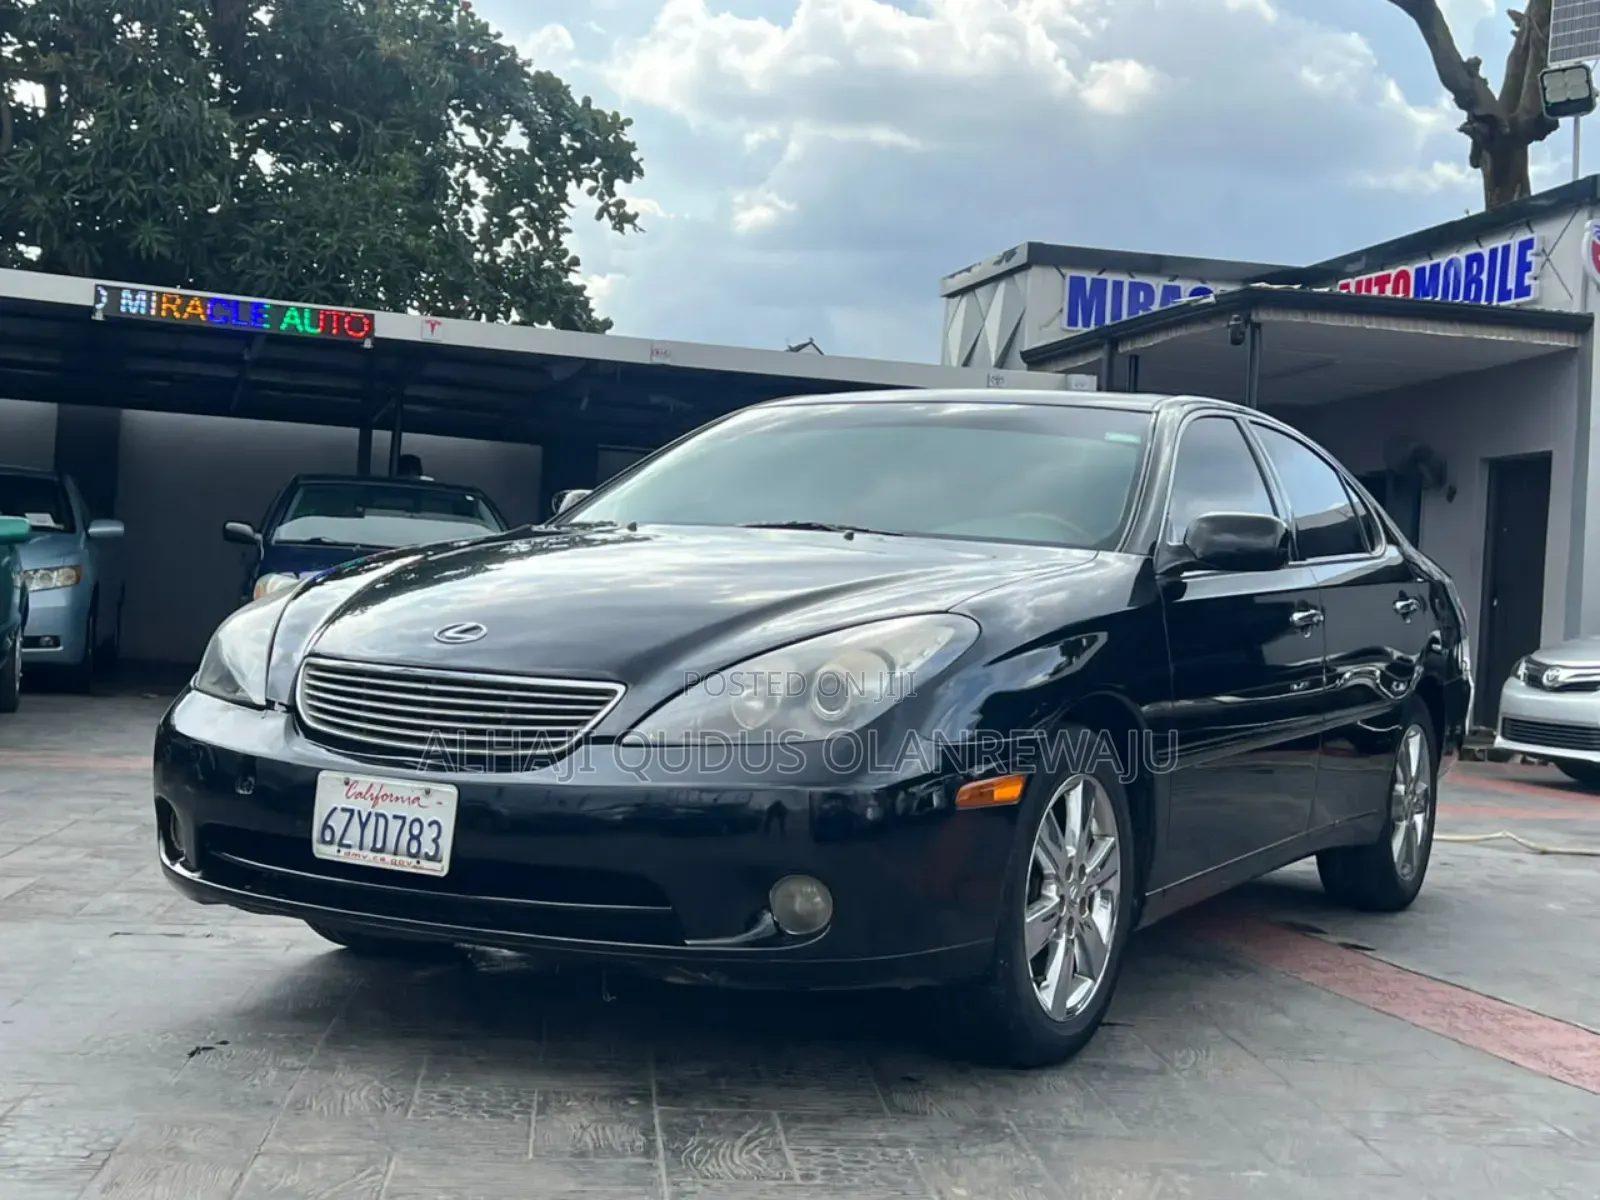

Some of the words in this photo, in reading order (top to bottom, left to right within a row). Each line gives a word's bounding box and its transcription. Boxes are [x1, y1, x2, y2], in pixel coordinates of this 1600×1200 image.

[1338, 237, 1536, 305] TOMOBILE
[120, 289, 271, 329] MIRACLE
[279, 306, 371, 339] AUTO
[344, 780, 429, 809] California
[320, 805, 443, 864] 6ZYD783
